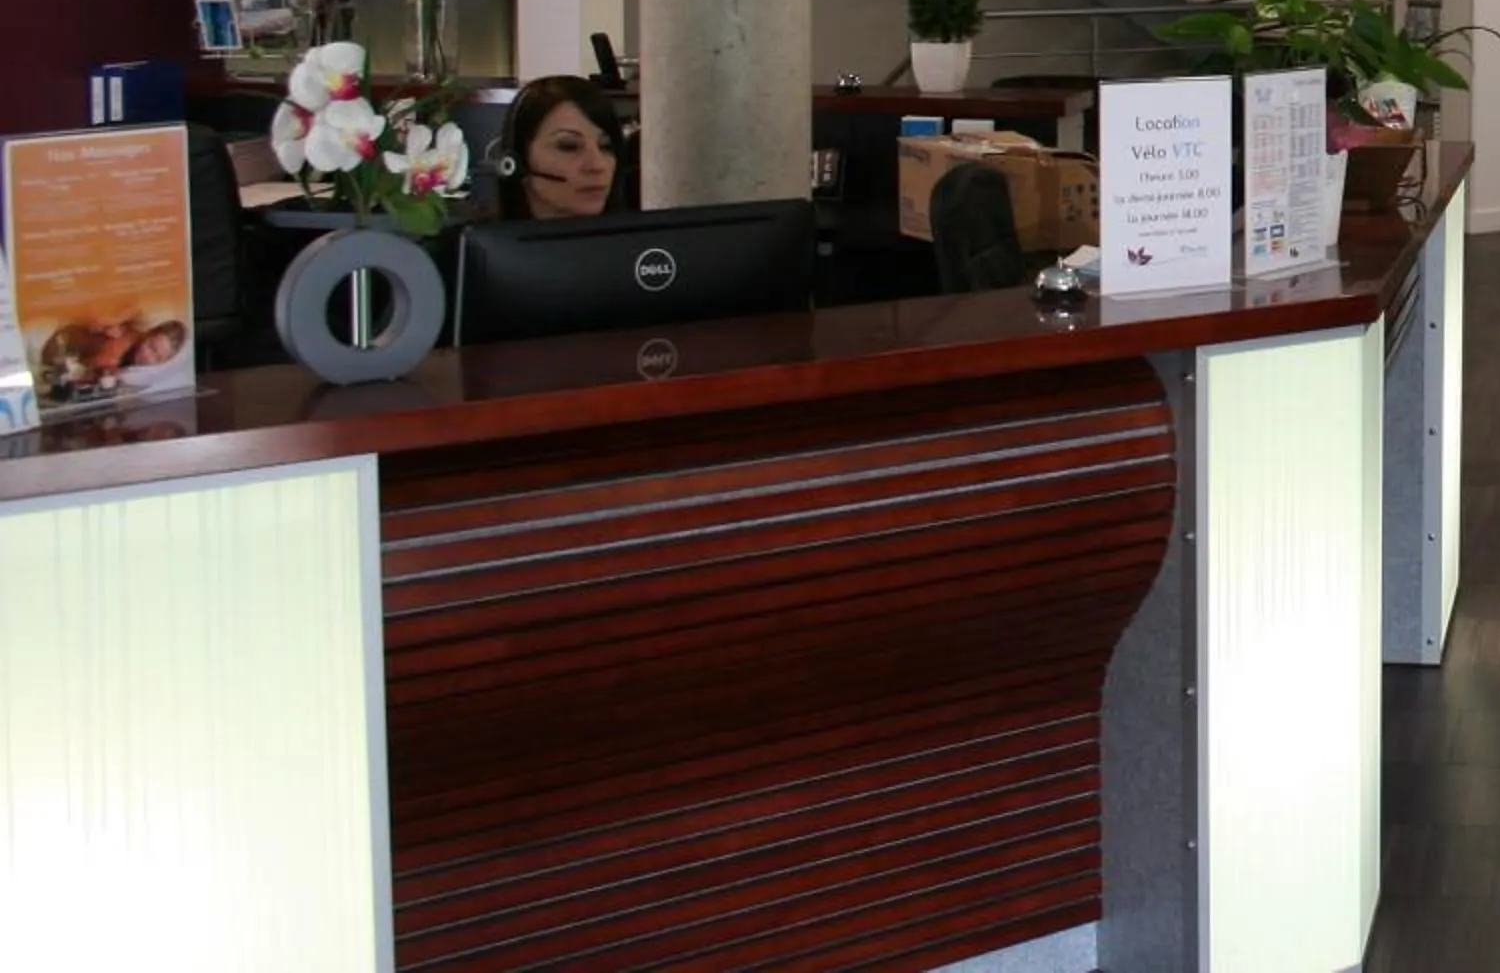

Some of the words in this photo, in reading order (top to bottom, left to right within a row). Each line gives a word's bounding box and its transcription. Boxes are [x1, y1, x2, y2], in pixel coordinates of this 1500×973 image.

[1135, 115, 1201, 132] Location
[1131, 144, 1167, 160] Vélo
[1172, 142, 1203, 159] VTC
[640, 264, 672, 276] DELL
